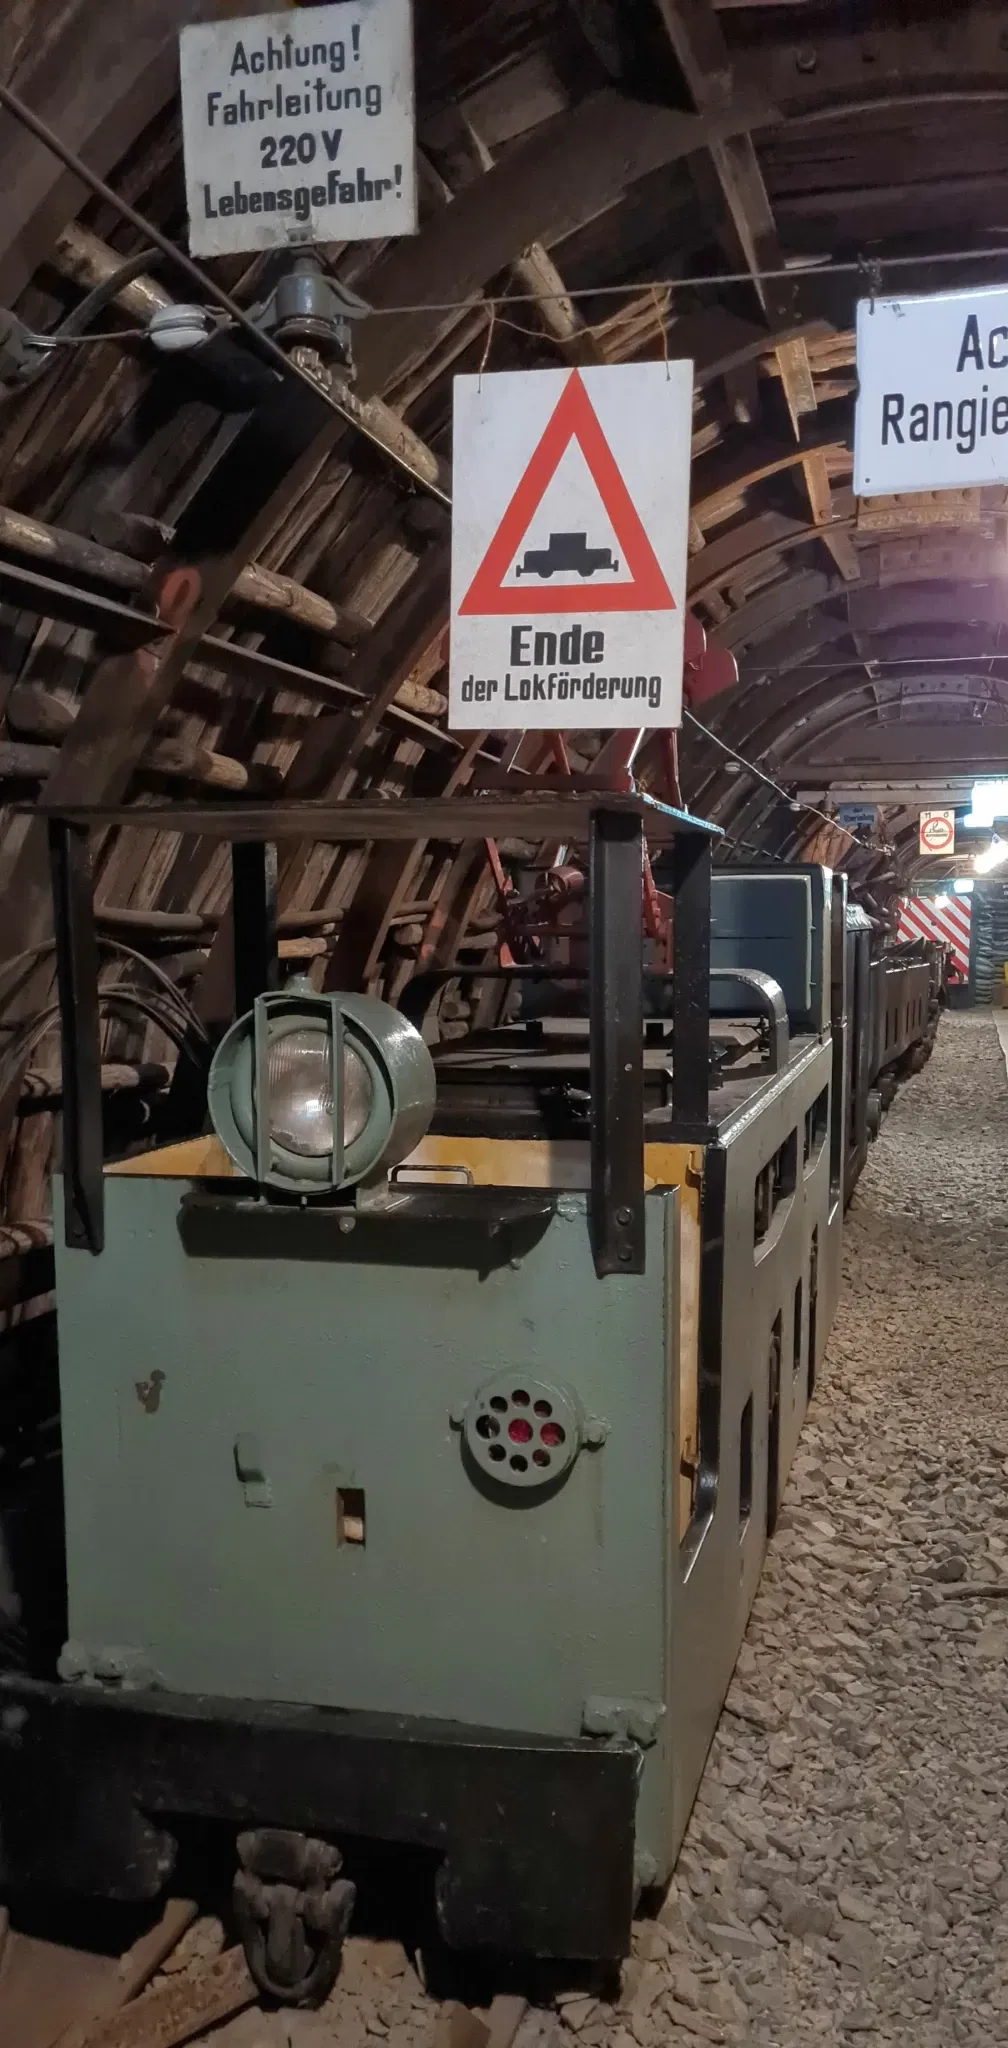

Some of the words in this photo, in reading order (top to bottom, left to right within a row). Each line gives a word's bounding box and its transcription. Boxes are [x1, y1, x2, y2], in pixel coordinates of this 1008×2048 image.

[230, 24, 361, 76] Achtung!
[207, 77, 382, 126] Fahrleitung
[260, 132, 316, 169] 220
[321, 129, 342, 161] V
[204, 164, 402, 221] Lebensgefahr!
[956, 314, 1008, 373] Ac
[881, 384, 1008, 454] Rangie
[510, 624, 605, 666] Ende
[461, 675, 498, 702] der
[504, 672, 662, 708] Lokförderung
